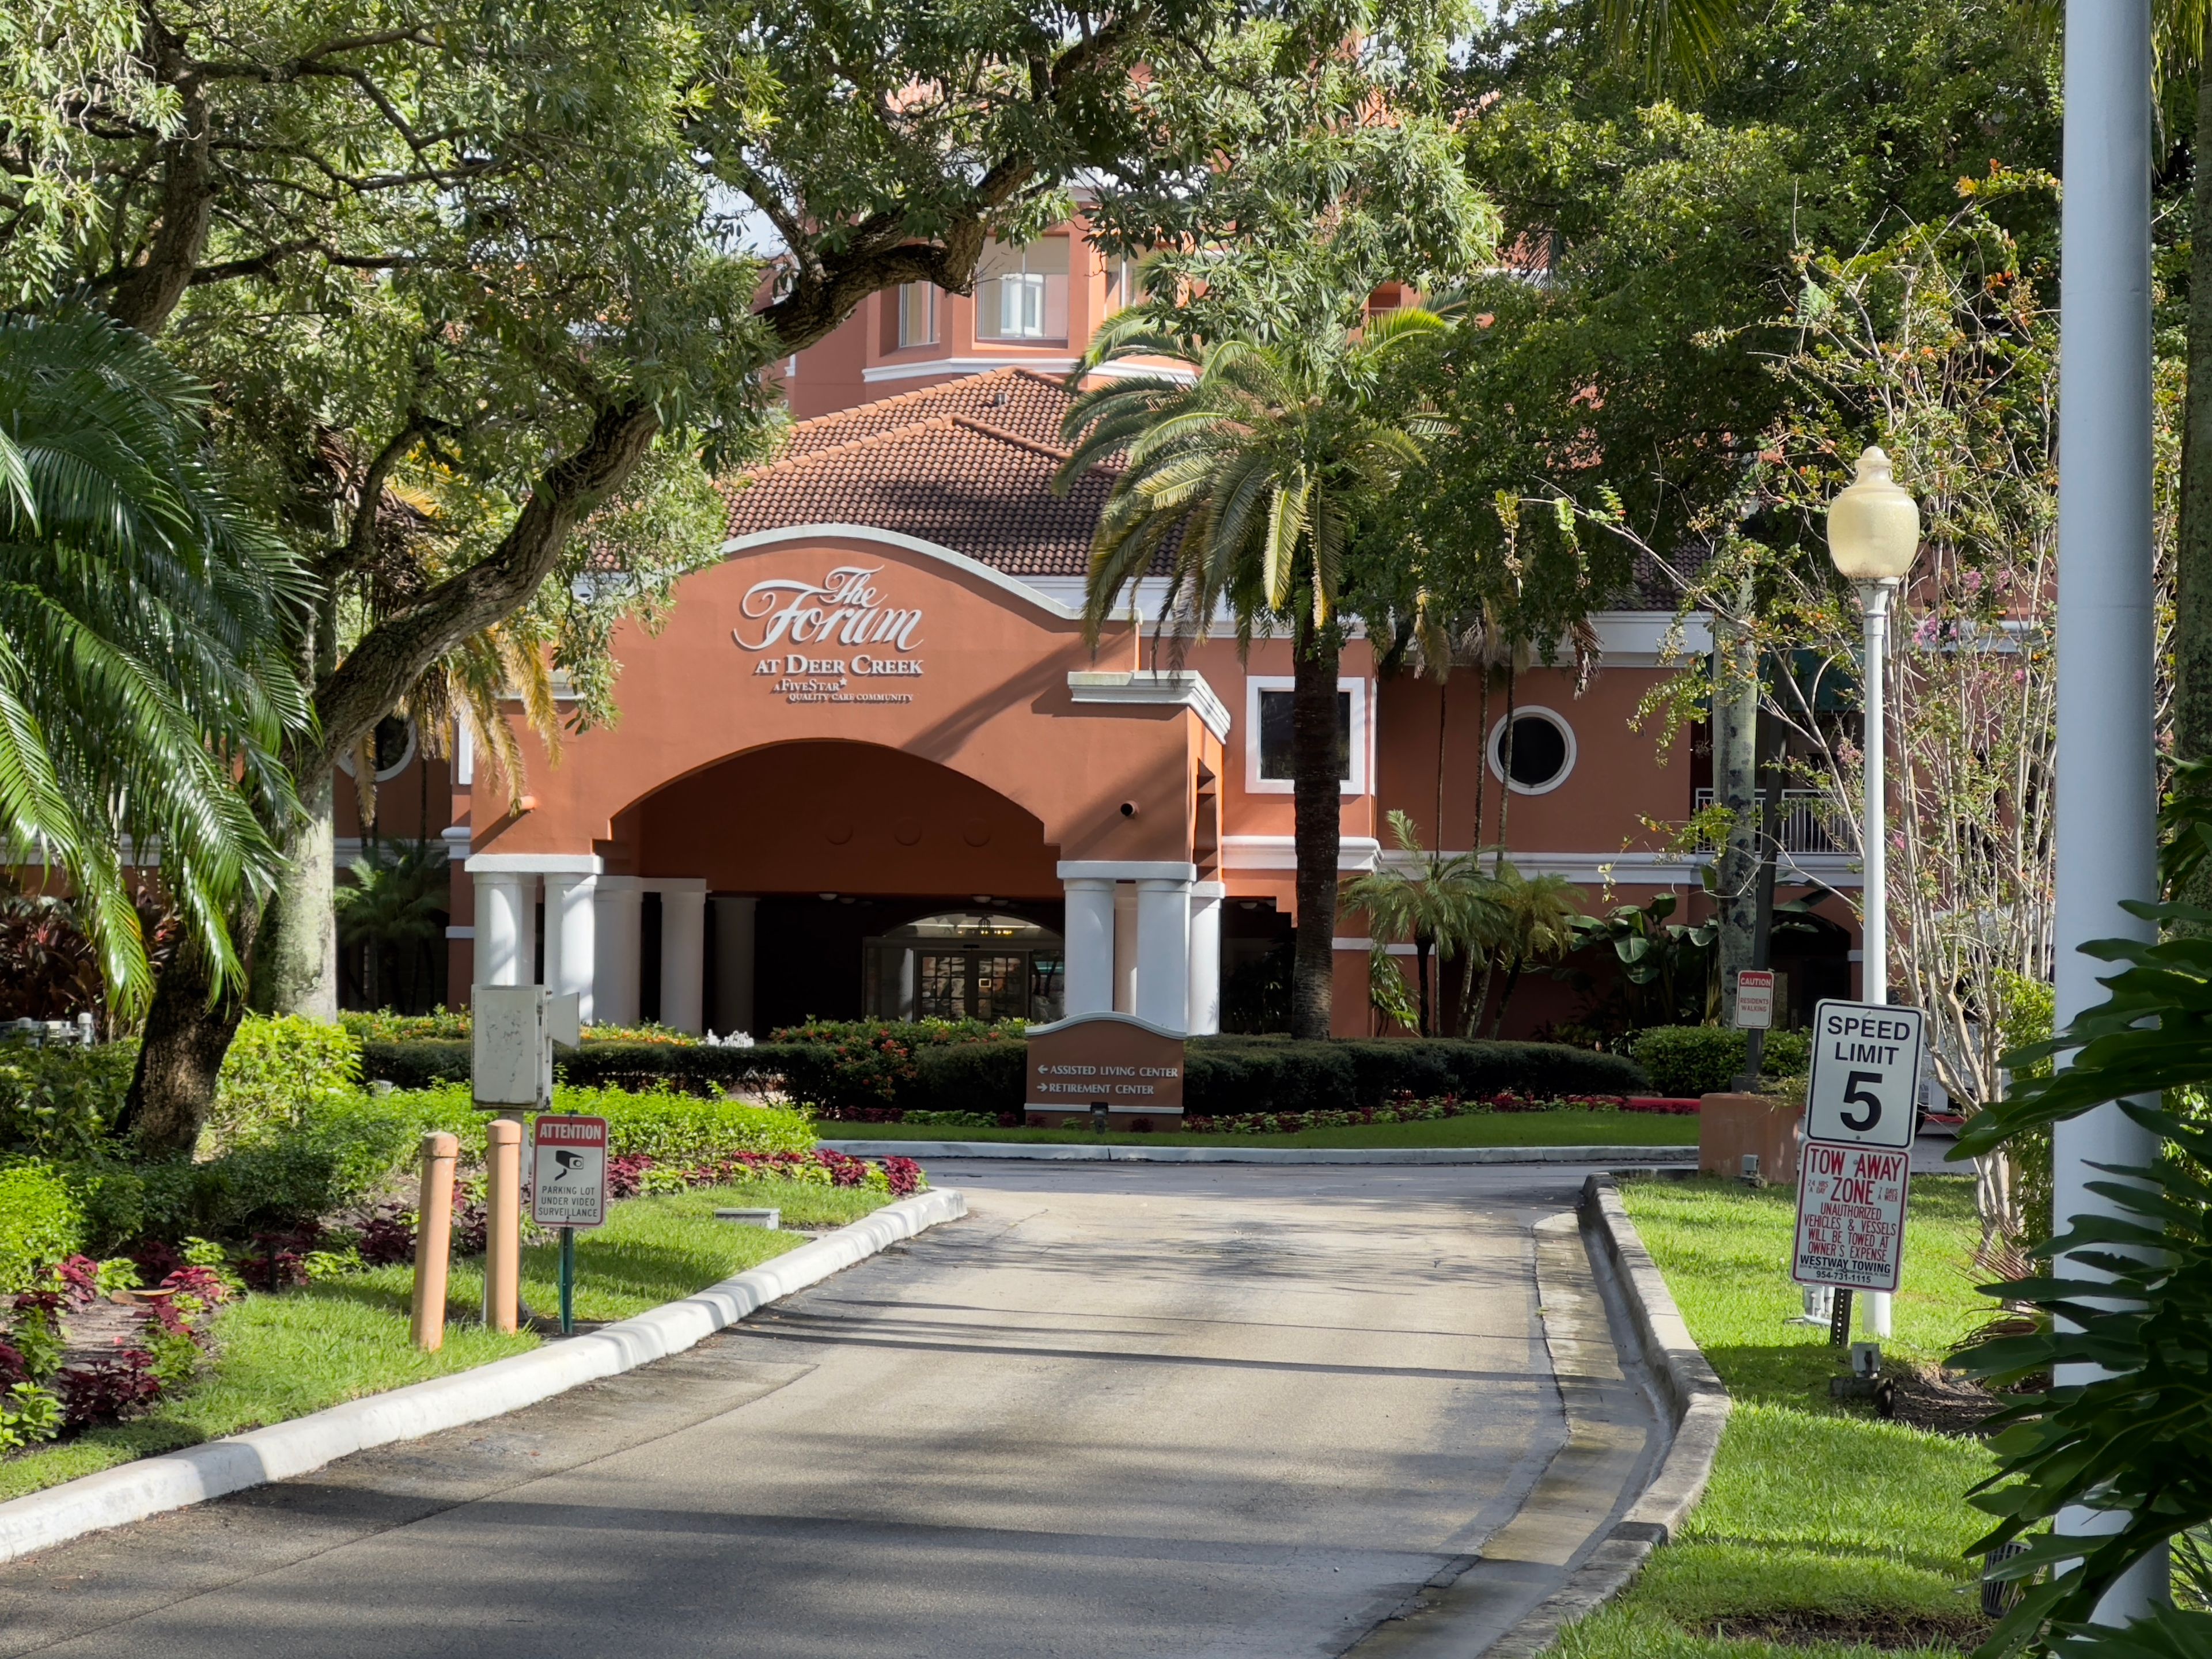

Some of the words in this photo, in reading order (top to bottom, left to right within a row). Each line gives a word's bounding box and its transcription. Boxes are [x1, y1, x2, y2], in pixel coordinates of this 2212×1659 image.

[819, 565, 888, 607] The
[734, 579, 924, 650] Forum
[755, 659, 781, 673] AT
[785, 654, 846, 674] DEER
[851, 654, 924, 674] CREEK
[789, 693, 829, 702] QUALITY
[857, 694, 913, 702] COMMUNITY
[1740, 978, 1771, 986] CAUTION
[1827, 1016, 1910, 1041] SPEED
[1835, 1041, 1900, 1065] LIMIT
[1050, 1065, 1096, 1075] ASSISTED
[1100, 1066, 1135, 1077] LIVING
[1139, 1067, 1178, 1077] CENTER
[1049, 1083, 1111, 1093] RETIREMENT
[1115, 1085, 1154, 1094] CENTER
[1840, 1070, 1883, 1132] 5
[539, 1123, 601, 1139] ATTENTION
[1810, 1148, 1846, 1176] TOW
[1854, 1153, 1903, 1181] AWAY
[542, 1185, 577, 1195] PARKING
[580, 1187, 595, 1195] LOT
[1830, 1176, 1876, 1206] ZONE
[541, 1197, 569, 1205] UNDER
[572, 1198, 595, 1206] VIDEO
[1821, 1202, 1881, 1221] UNAUTHORIZED
[538, 1207, 598, 1217] SURVEILLANCE
[1804, 1214, 1842, 1230] VEHICLES
[1847, 1218, 1855, 1232] &
[1861, 1219, 1896, 1236] VESSELS
[1808, 1228, 1826, 1242] WILL
[1832, 1230, 1843, 1244] BE
[1848, 1232, 1875, 1247] TOWED
[1880, 1236, 1889, 1249] AT
[1808, 1241, 1845, 1257] OWNER'S
[1850, 1246, 1887, 1262] EXPENSE
[1800, 1254, 1849, 1270] WESTWAY
[1852, 1260, 1891, 1274] TOWING
[1816, 1270, 1872, 1283] 954-731-1115
